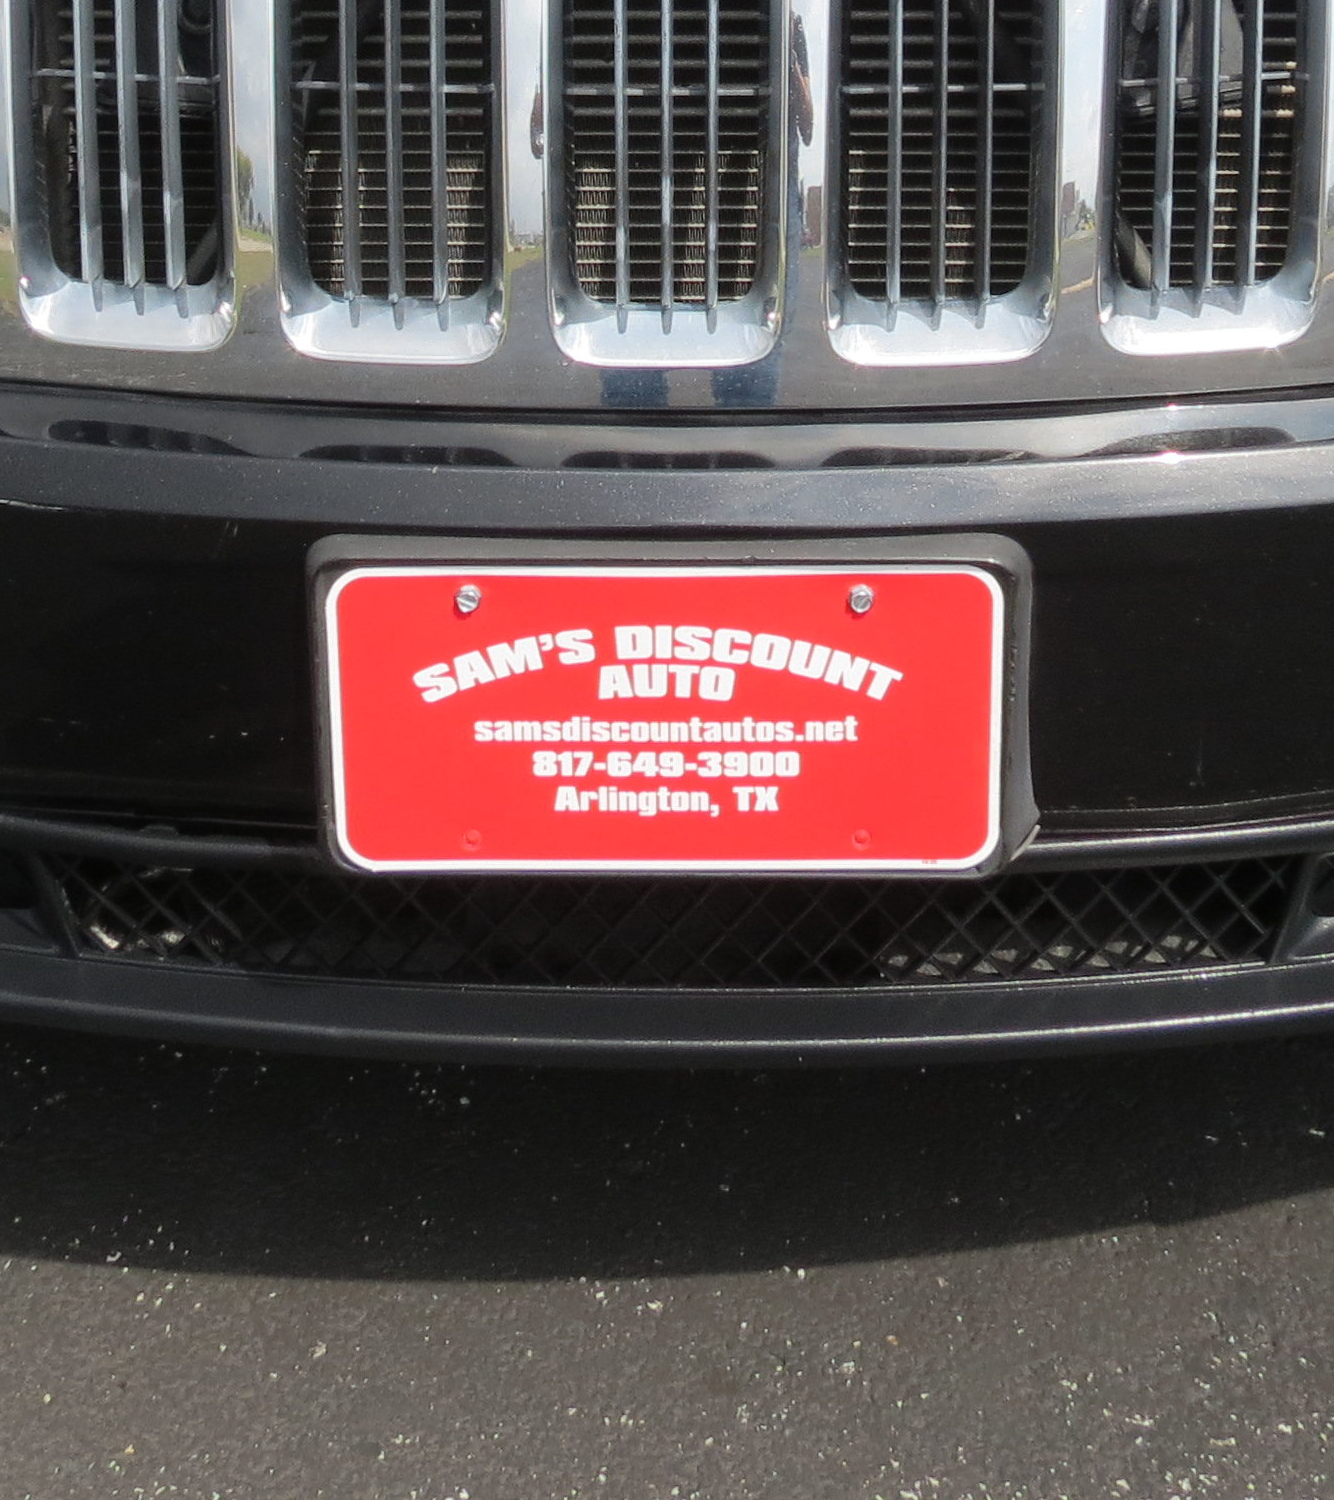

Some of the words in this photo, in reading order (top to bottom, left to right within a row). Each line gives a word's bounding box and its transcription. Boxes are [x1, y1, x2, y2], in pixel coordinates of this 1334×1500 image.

[412, 628, 595, 703] SAM'S
[614, 624, 903, 701] DISCOUNT
[598, 663, 736, 702] AUTO
[473, 715, 859, 743] samsdiscountautos.net
[532, 750, 801, 778] 817-649-3900
[554, 785, 720, 818] Arlington,
[732, 785, 779, 812] TX
